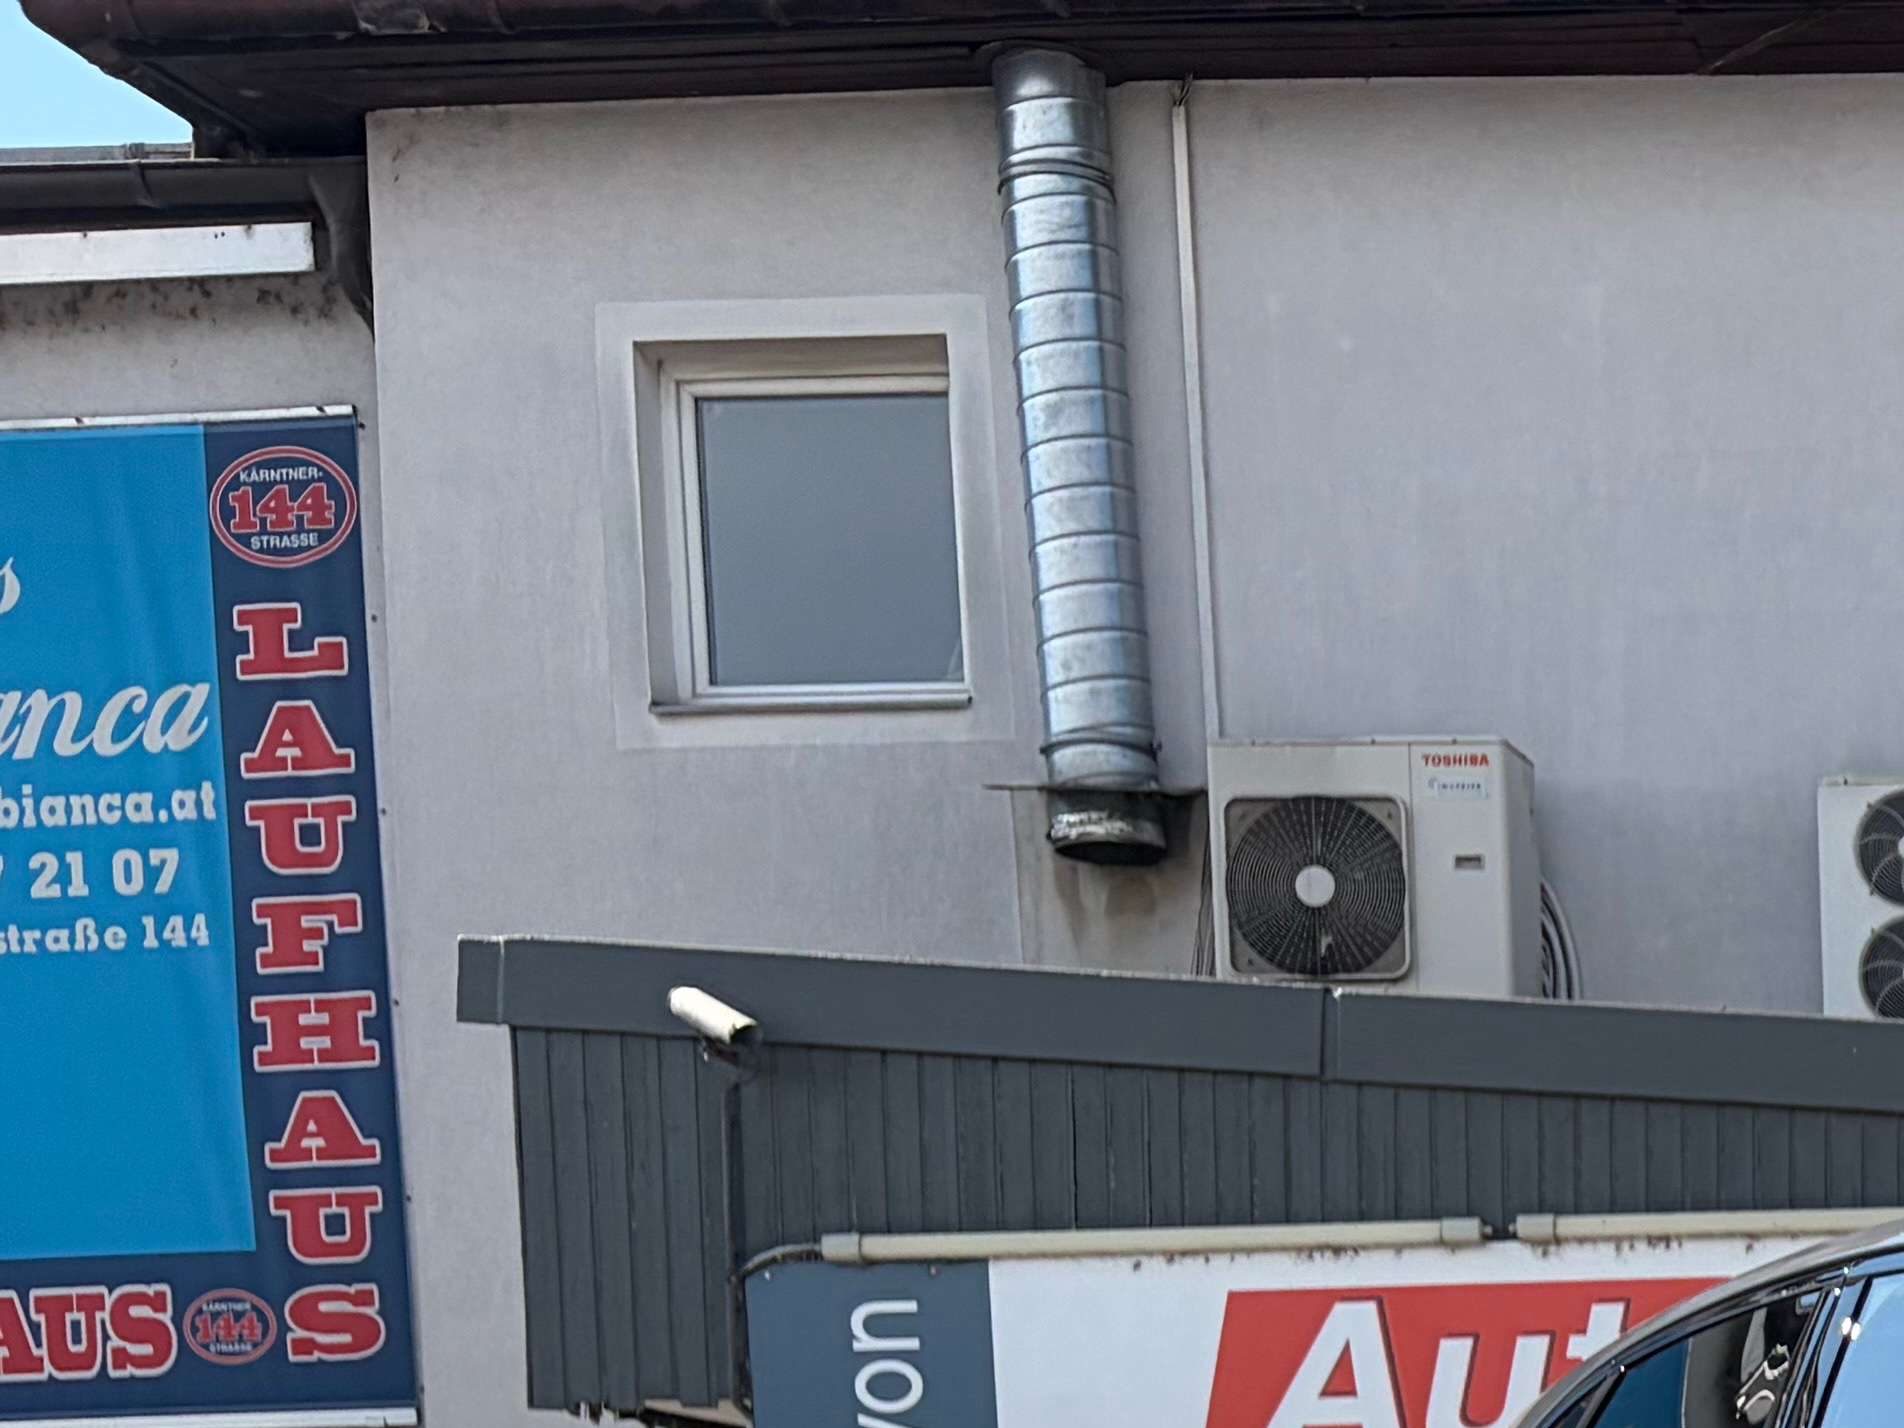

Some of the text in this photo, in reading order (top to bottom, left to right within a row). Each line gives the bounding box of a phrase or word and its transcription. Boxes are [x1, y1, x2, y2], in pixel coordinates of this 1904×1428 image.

[229, 483, 335, 533] 144
[251, 532, 319, 550] STRASSE
[1422, 752, 1489, 768] TOSHIBA
[28, 851, 89, 899] 21
[112, 848, 179, 896] 07
[142, 913, 210, 949] 144
[195, 1310, 262, 1344] 144
